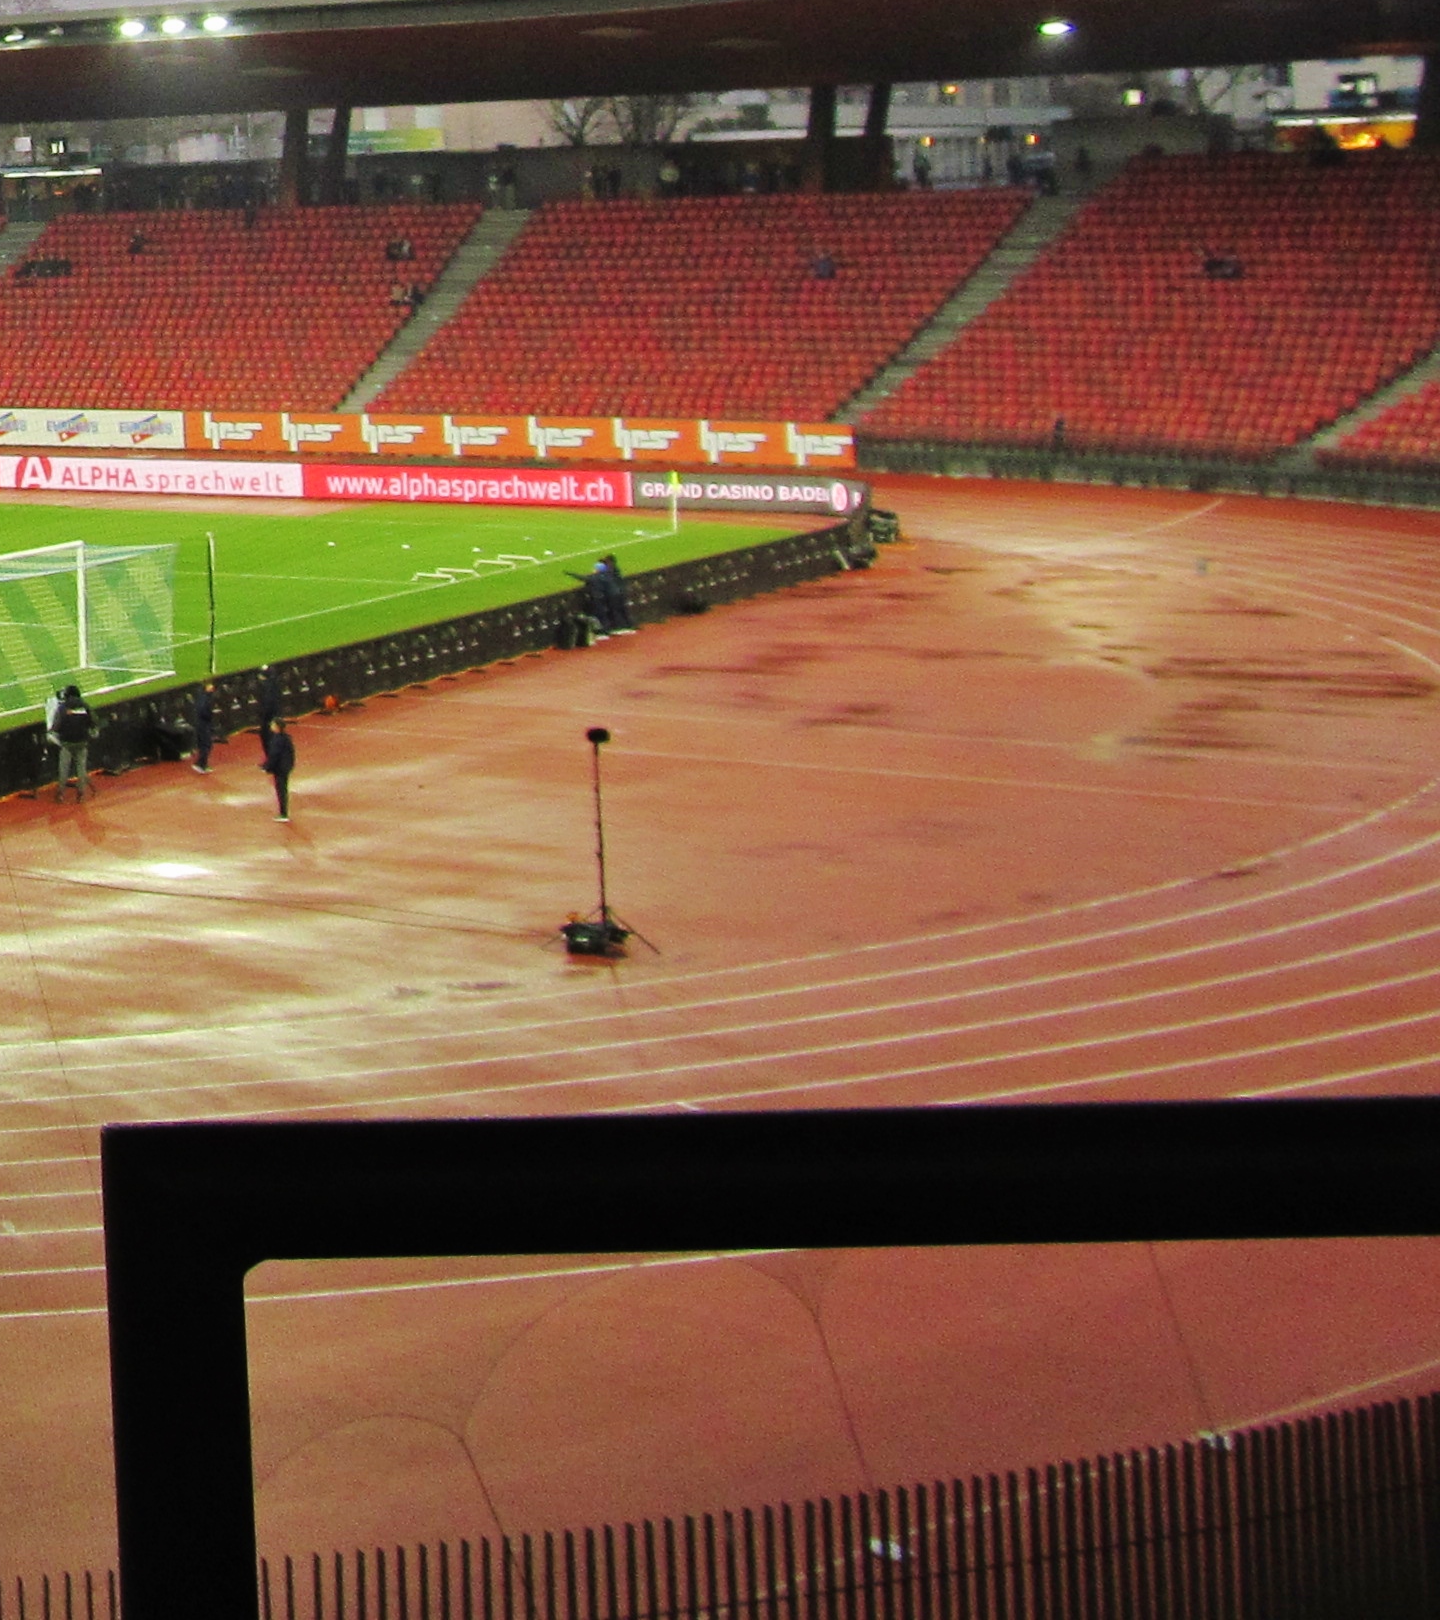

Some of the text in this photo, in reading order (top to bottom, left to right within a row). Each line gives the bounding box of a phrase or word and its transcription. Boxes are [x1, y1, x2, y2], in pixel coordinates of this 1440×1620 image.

[62, 465, 283, 494] ALPHA sprachwelt
[327, 471, 614, 502] www.alphasprachwelt.ch
[641, 483, 702, 499] GRAND
[706, 484, 773, 500] CASINO
